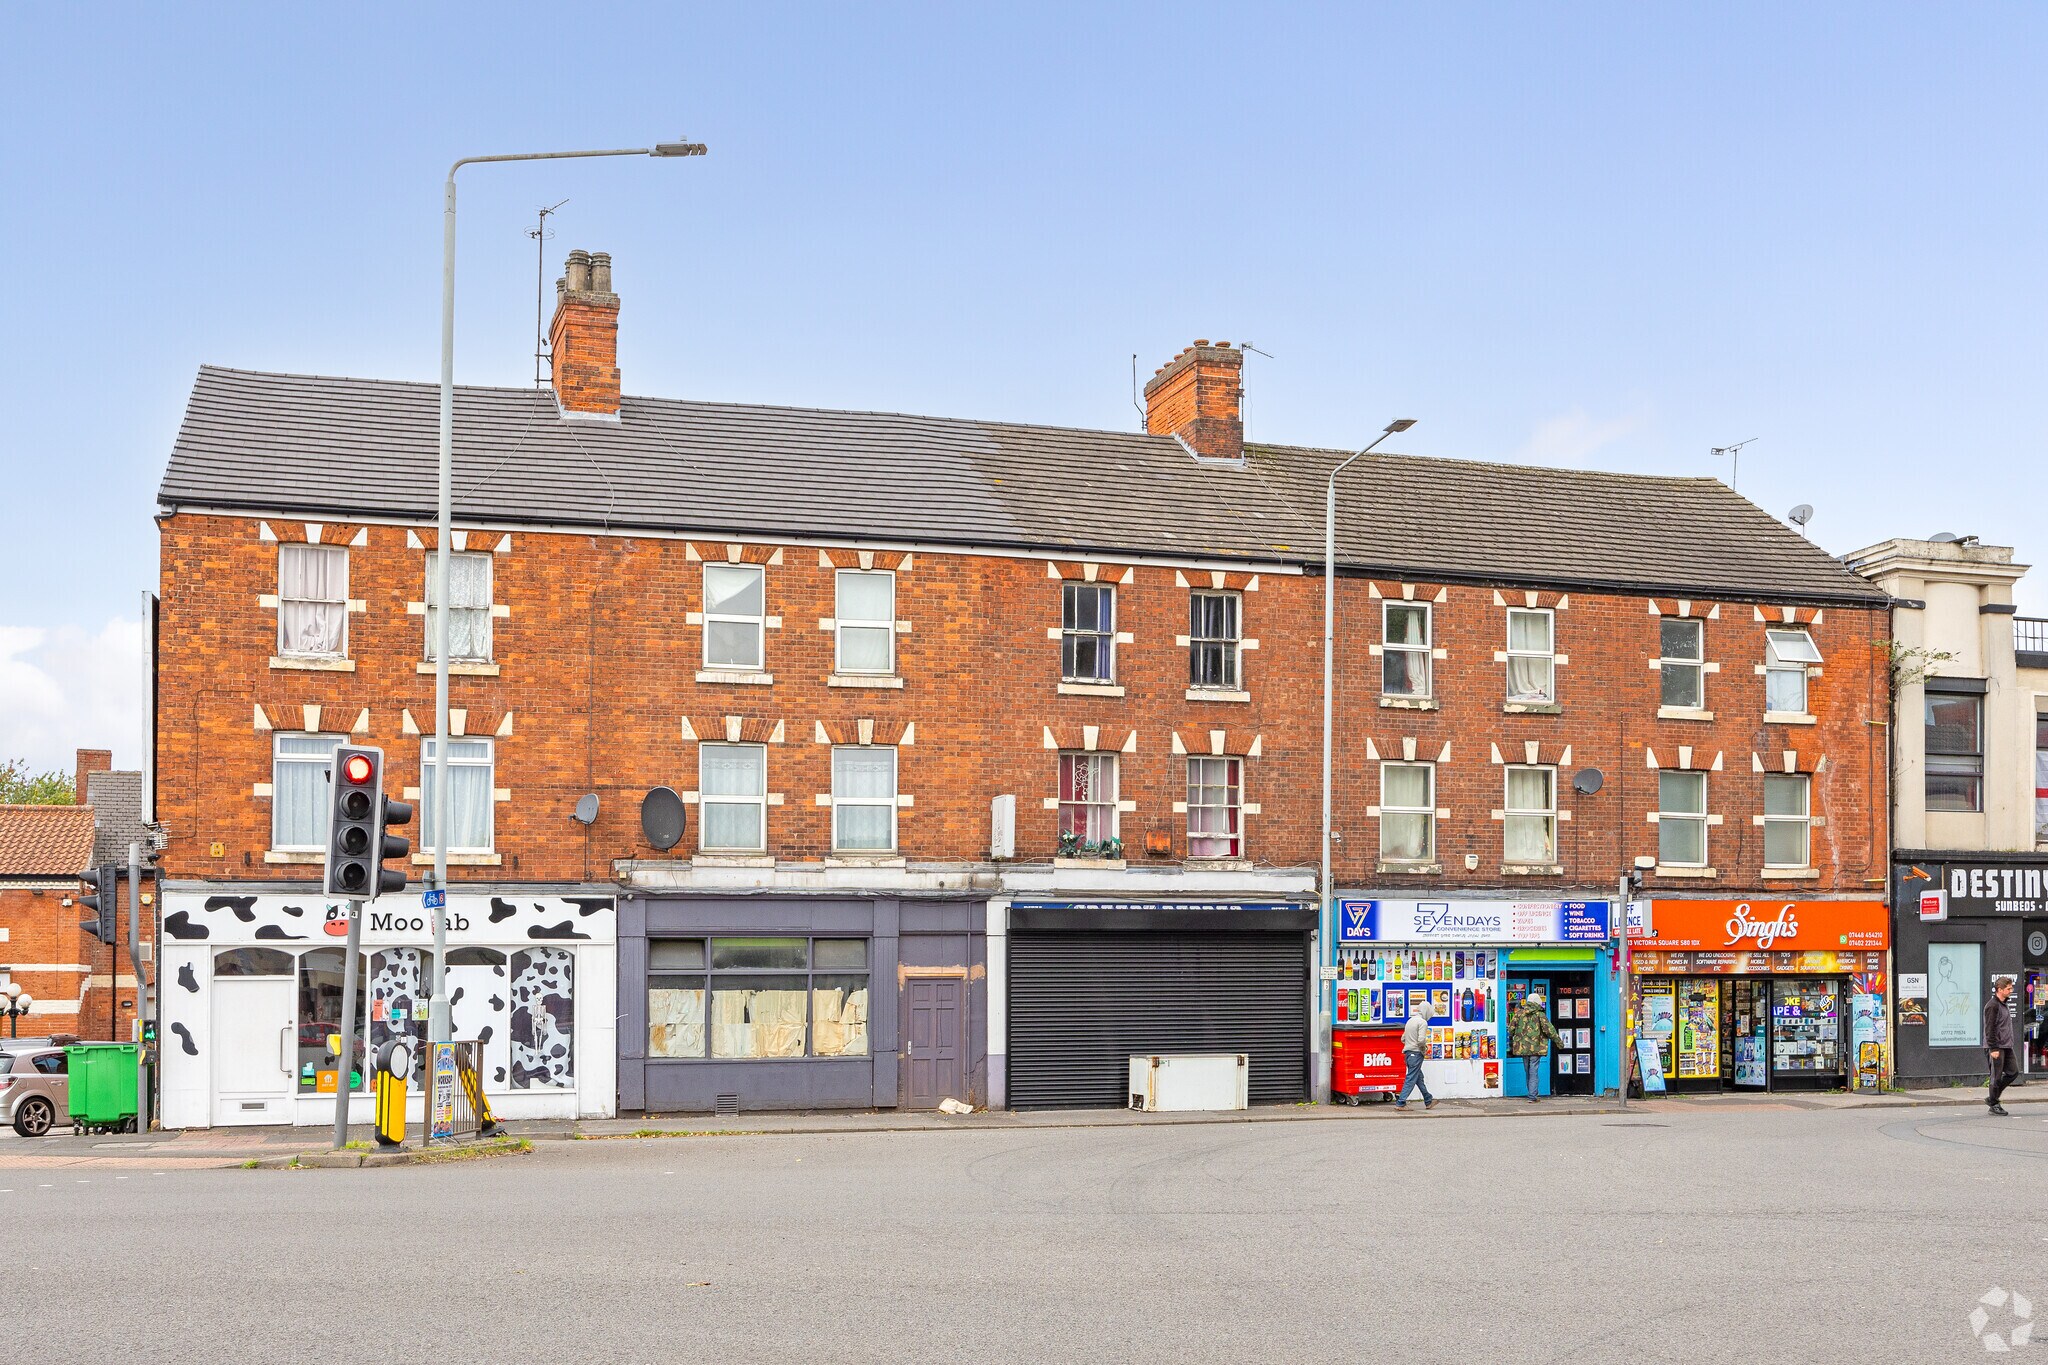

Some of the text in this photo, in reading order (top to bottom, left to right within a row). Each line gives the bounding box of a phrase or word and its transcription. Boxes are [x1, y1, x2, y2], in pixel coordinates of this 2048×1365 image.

[1995, 901, 2036, 912] SUNBEDS
[371, 912, 423, 931] Moo
[1413, 915, 1501, 926] SEVEN DAYS
[1614, 916, 1641, 928] LINCE
[1724, 903, 1798, 950] Singh's
[1347, 927, 1371, 937] DAYS
[1363, 1052, 1392, 1067] Biffa
